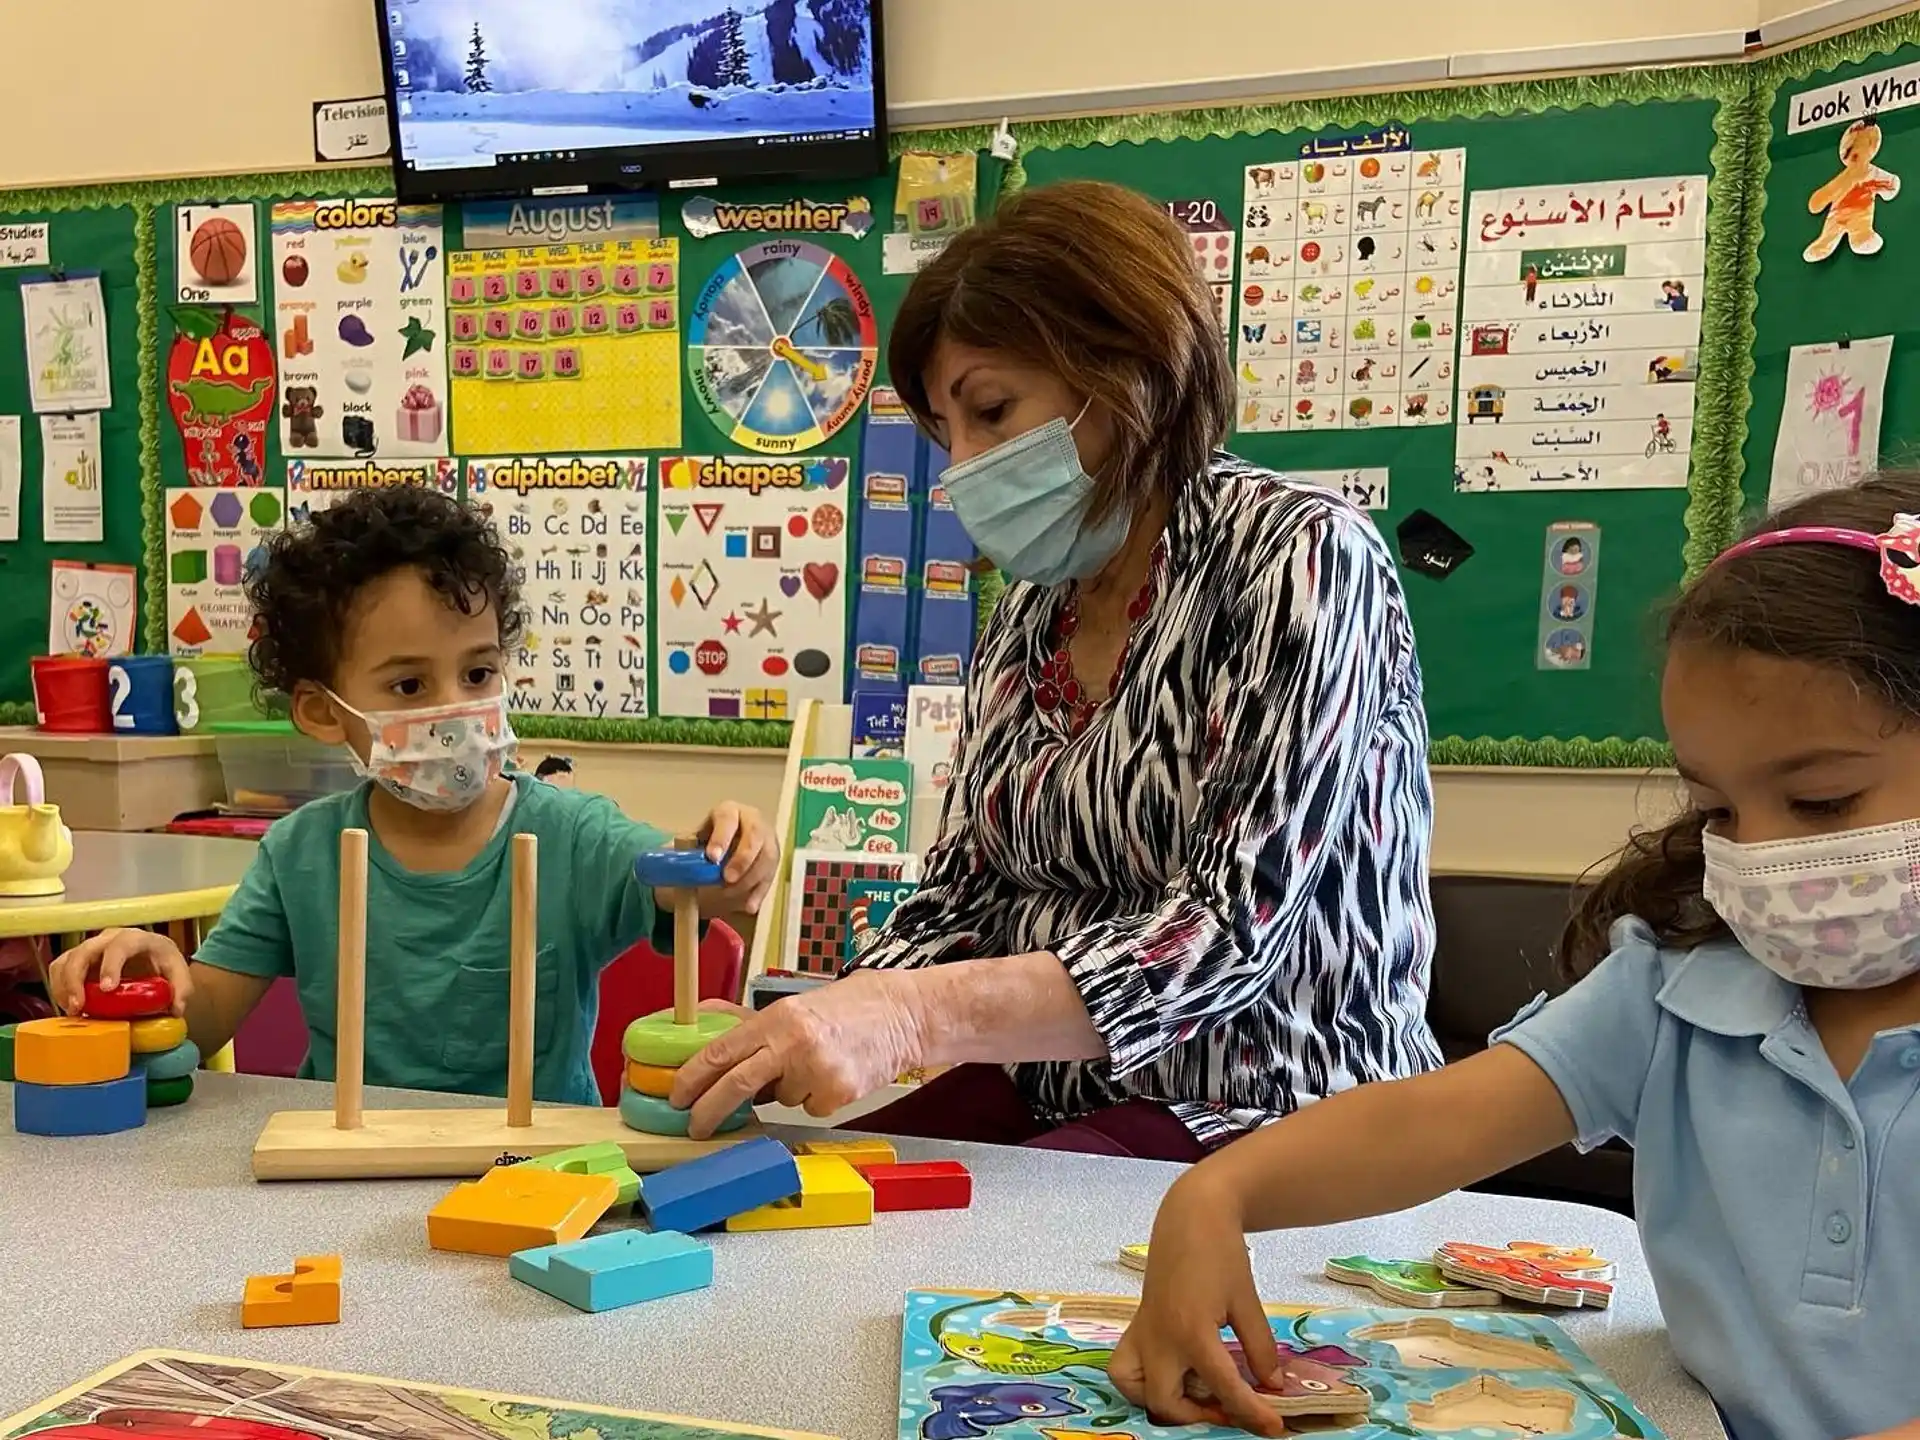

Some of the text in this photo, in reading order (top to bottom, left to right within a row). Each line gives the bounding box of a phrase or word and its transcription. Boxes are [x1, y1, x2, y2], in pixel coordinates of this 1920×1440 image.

[1798, 77, 1920, 126] Look Wha
[321, 105, 385, 121] Television
[181, 210, 192, 232] 1
[314, 199, 398, 230] colors
[507, 199, 615, 242] August
[714, 199, 848, 232] weather
[0, 226, 45, 240] Studies
[402, 233, 427, 244] blue
[286, 239, 305, 249] red
[763, 241, 801, 257] rainy
[491, 283, 500, 295] 2
[525, 278, 532, 290] 3
[556, 278, 564, 290] 4
[587, 274, 595, 287] 5
[623, 274, 630, 287] 6
[657, 272, 664, 284] 7
[180, 286, 210, 302] One
[400, 298, 433, 309] green
[696, 273, 724, 321] cloudy
[846, 273, 871, 318] windy
[337, 298, 373, 312] purple
[462, 308, 667, 334] 8 9 10 11 12 13 14
[191, 337, 250, 376] Aa
[460, 355, 573, 372] 15 16 17 18
[284, 368, 318, 381] brown
[405, 368, 430, 379] pink
[694, 368, 721, 415] snowy
[343, 402, 373, 412] black
[756, 435, 797, 451] sunny
[312, 461, 427, 490] numbers
[493, 458, 618, 496] alphabet
[699, 457, 804, 495] shapes
[509, 515, 644, 535] Bb Cc Dd Ee
[536, 560, 644, 585] Hh Ii Jj Kk
[543, 606, 644, 631] Nn Oo Pp
[518, 648, 644, 669] Rr Ss Tt Uu
[697, 651, 726, 665] STOP
[108, 665, 136, 728] 2
[173, 666, 200, 729] 3
[508, 692, 645, 717] Ww Xx Yy Zz
[803, 770, 847, 787] Horton
[848, 784, 900, 801] Hatches
[874, 811, 897, 826] the
[867, 839, 893, 853] Egg
[864, 889, 891, 903] THE
